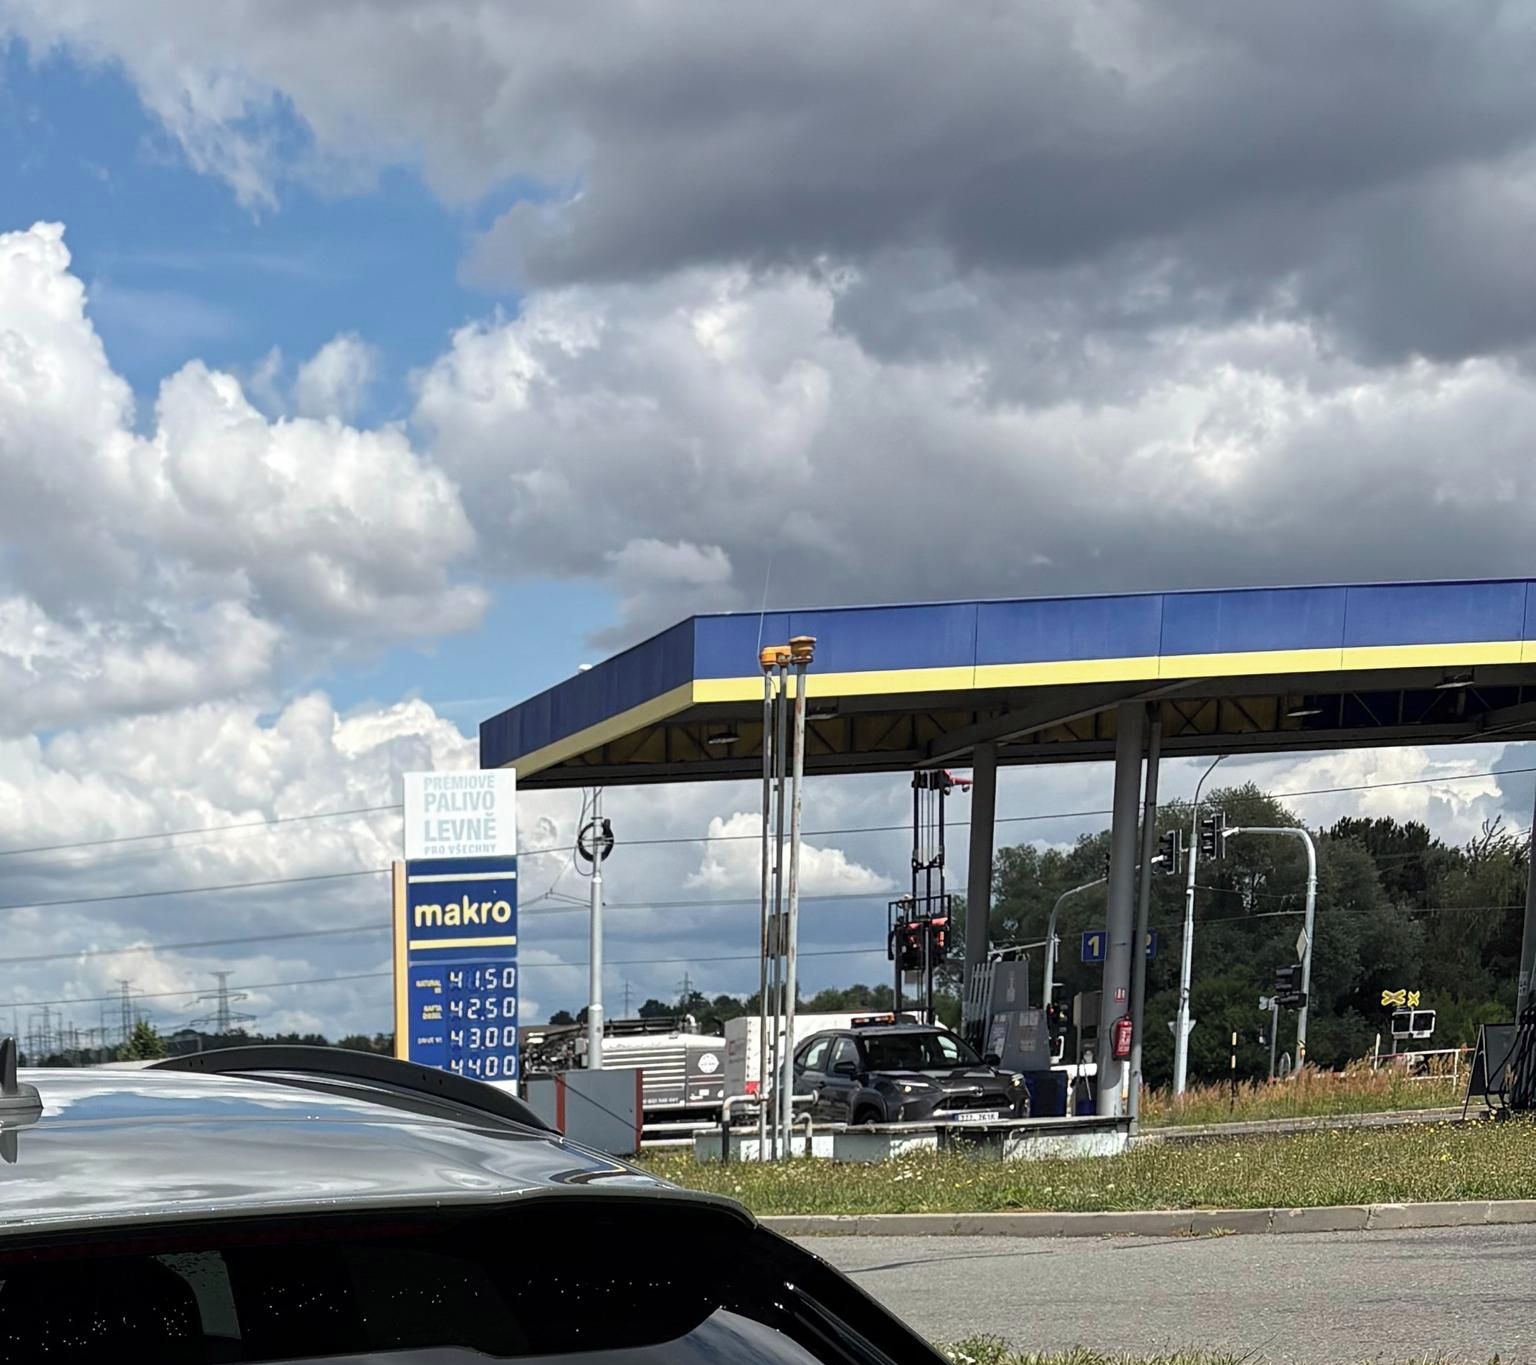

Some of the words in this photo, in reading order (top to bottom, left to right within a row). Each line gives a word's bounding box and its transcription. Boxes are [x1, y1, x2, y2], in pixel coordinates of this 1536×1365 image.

[424, 790, 495, 812] PALIVO
[424, 812, 497, 842] LEVNĚ
[424, 845, 446, 856] PRO
[414, 894, 511, 927] makro
[1087, 935, 1100, 957] 1
[450, 968, 515, 991] 41.50
[450, 997, 516, 1020] 42.50
[451, 1026, 516, 1050] 43.00
[451, 1055, 516, 1079] 44.00
